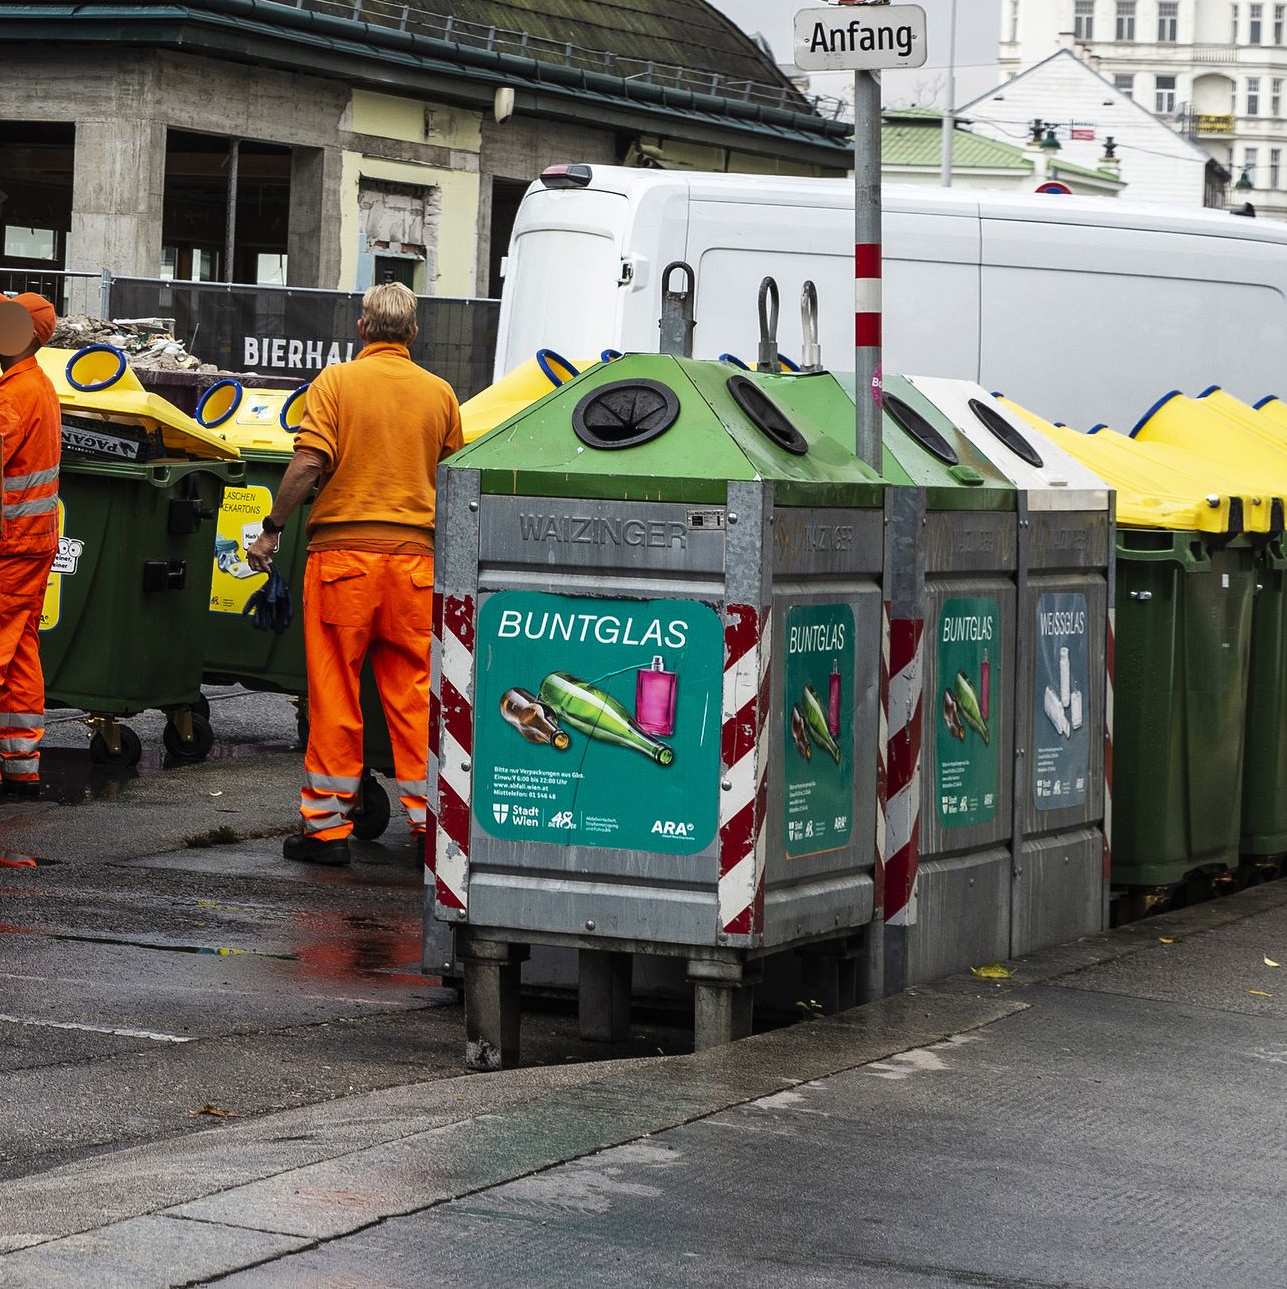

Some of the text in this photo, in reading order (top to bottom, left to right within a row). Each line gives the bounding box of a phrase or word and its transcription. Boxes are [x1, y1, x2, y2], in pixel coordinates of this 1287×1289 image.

[809, 20, 913, 57] Anfang
[519, 512, 688, 549] WAIZINGER
[55, 554, 73, 563] einer,
[498, 610, 689, 649] BUNTGLAS
[942, 615, 994, 642] BUNTGLAS
[1040, 610, 1085, 637] WEISSGLAS
[789, 623, 846, 654] BUNTGLAS
[494, 766, 509, 774] Bitte
[519, 768, 560, 778] Verpackungen
[493, 782, 549, 792] www.abfall.wien.at
[493, 789, 528, 798] Misttelefon:
[512, 805, 539, 817] Stadt
[512, 815, 539, 827] Wien
[650, 820, 687, 836] ARA
